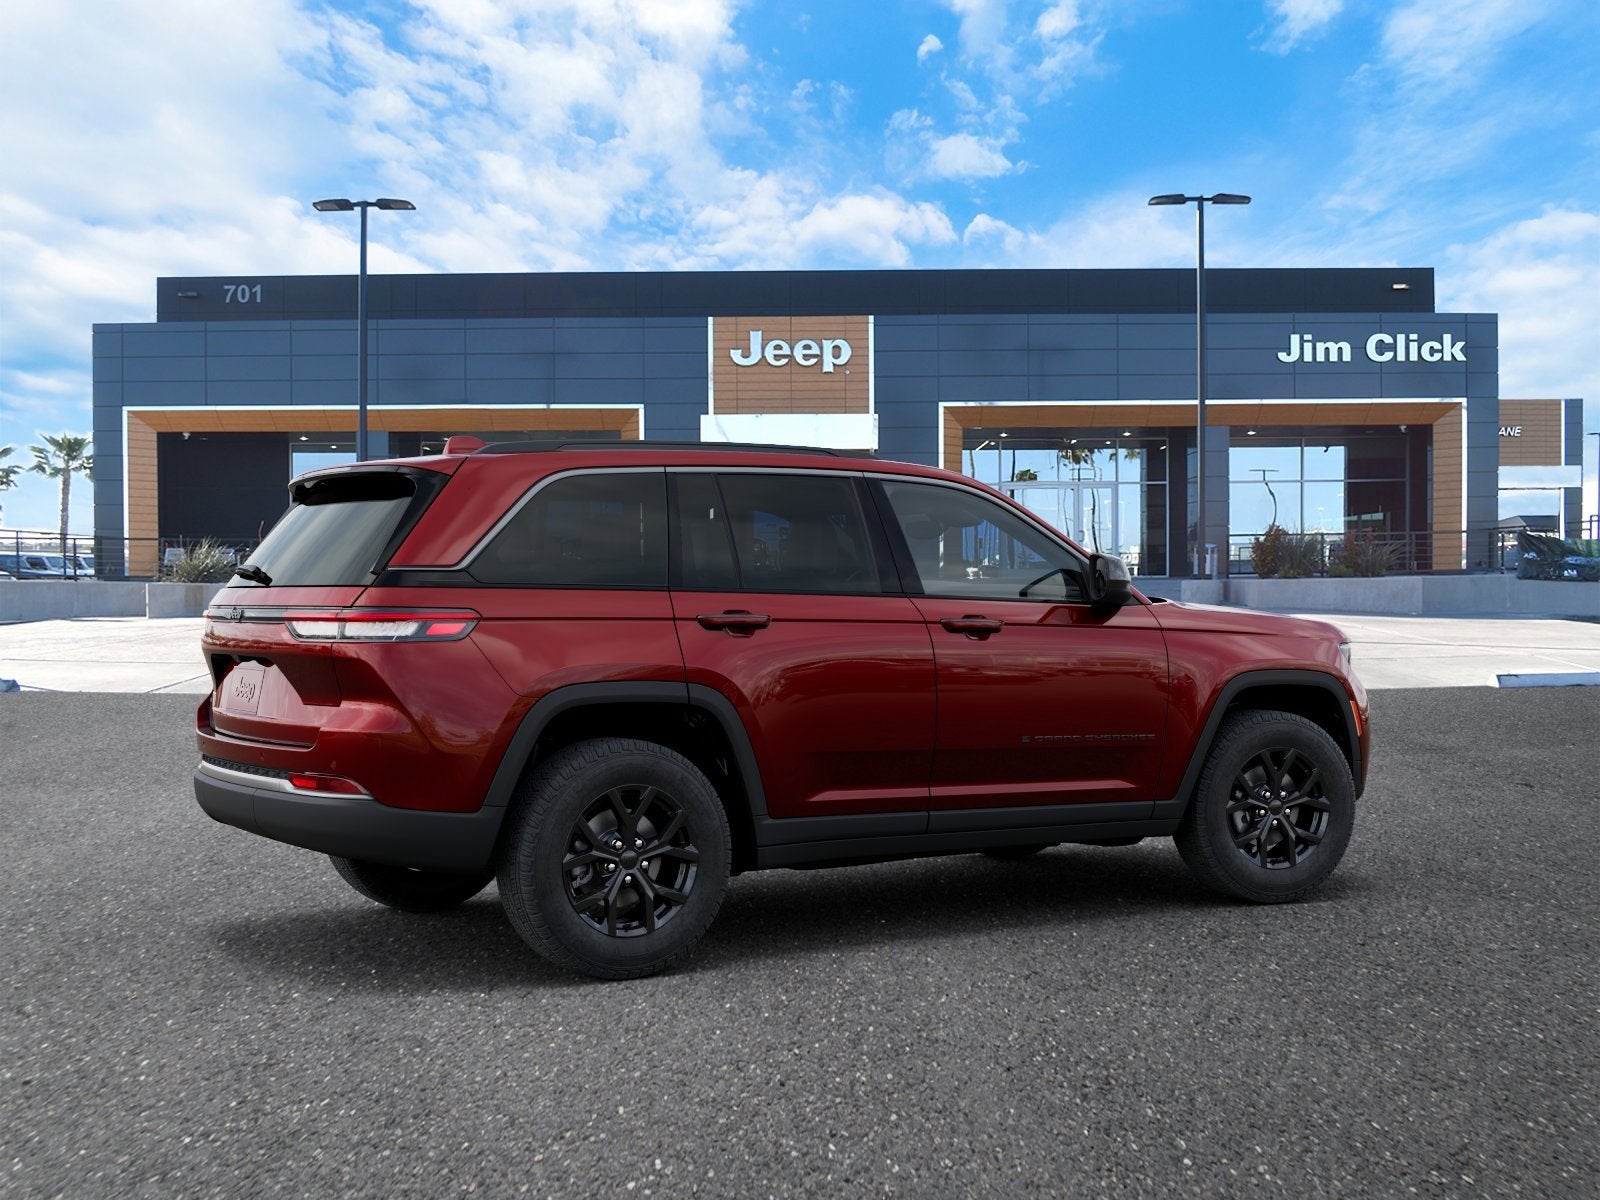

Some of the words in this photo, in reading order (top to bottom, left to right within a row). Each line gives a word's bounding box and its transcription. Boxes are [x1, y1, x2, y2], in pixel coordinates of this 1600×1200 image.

[223, 284, 262, 304] 701
[730, 330, 852, 373] Jeep
[1277, 333, 1352, 363] Jim
[1365, 333, 1467, 363] Click
[235, 676, 256, 704] Jeep
